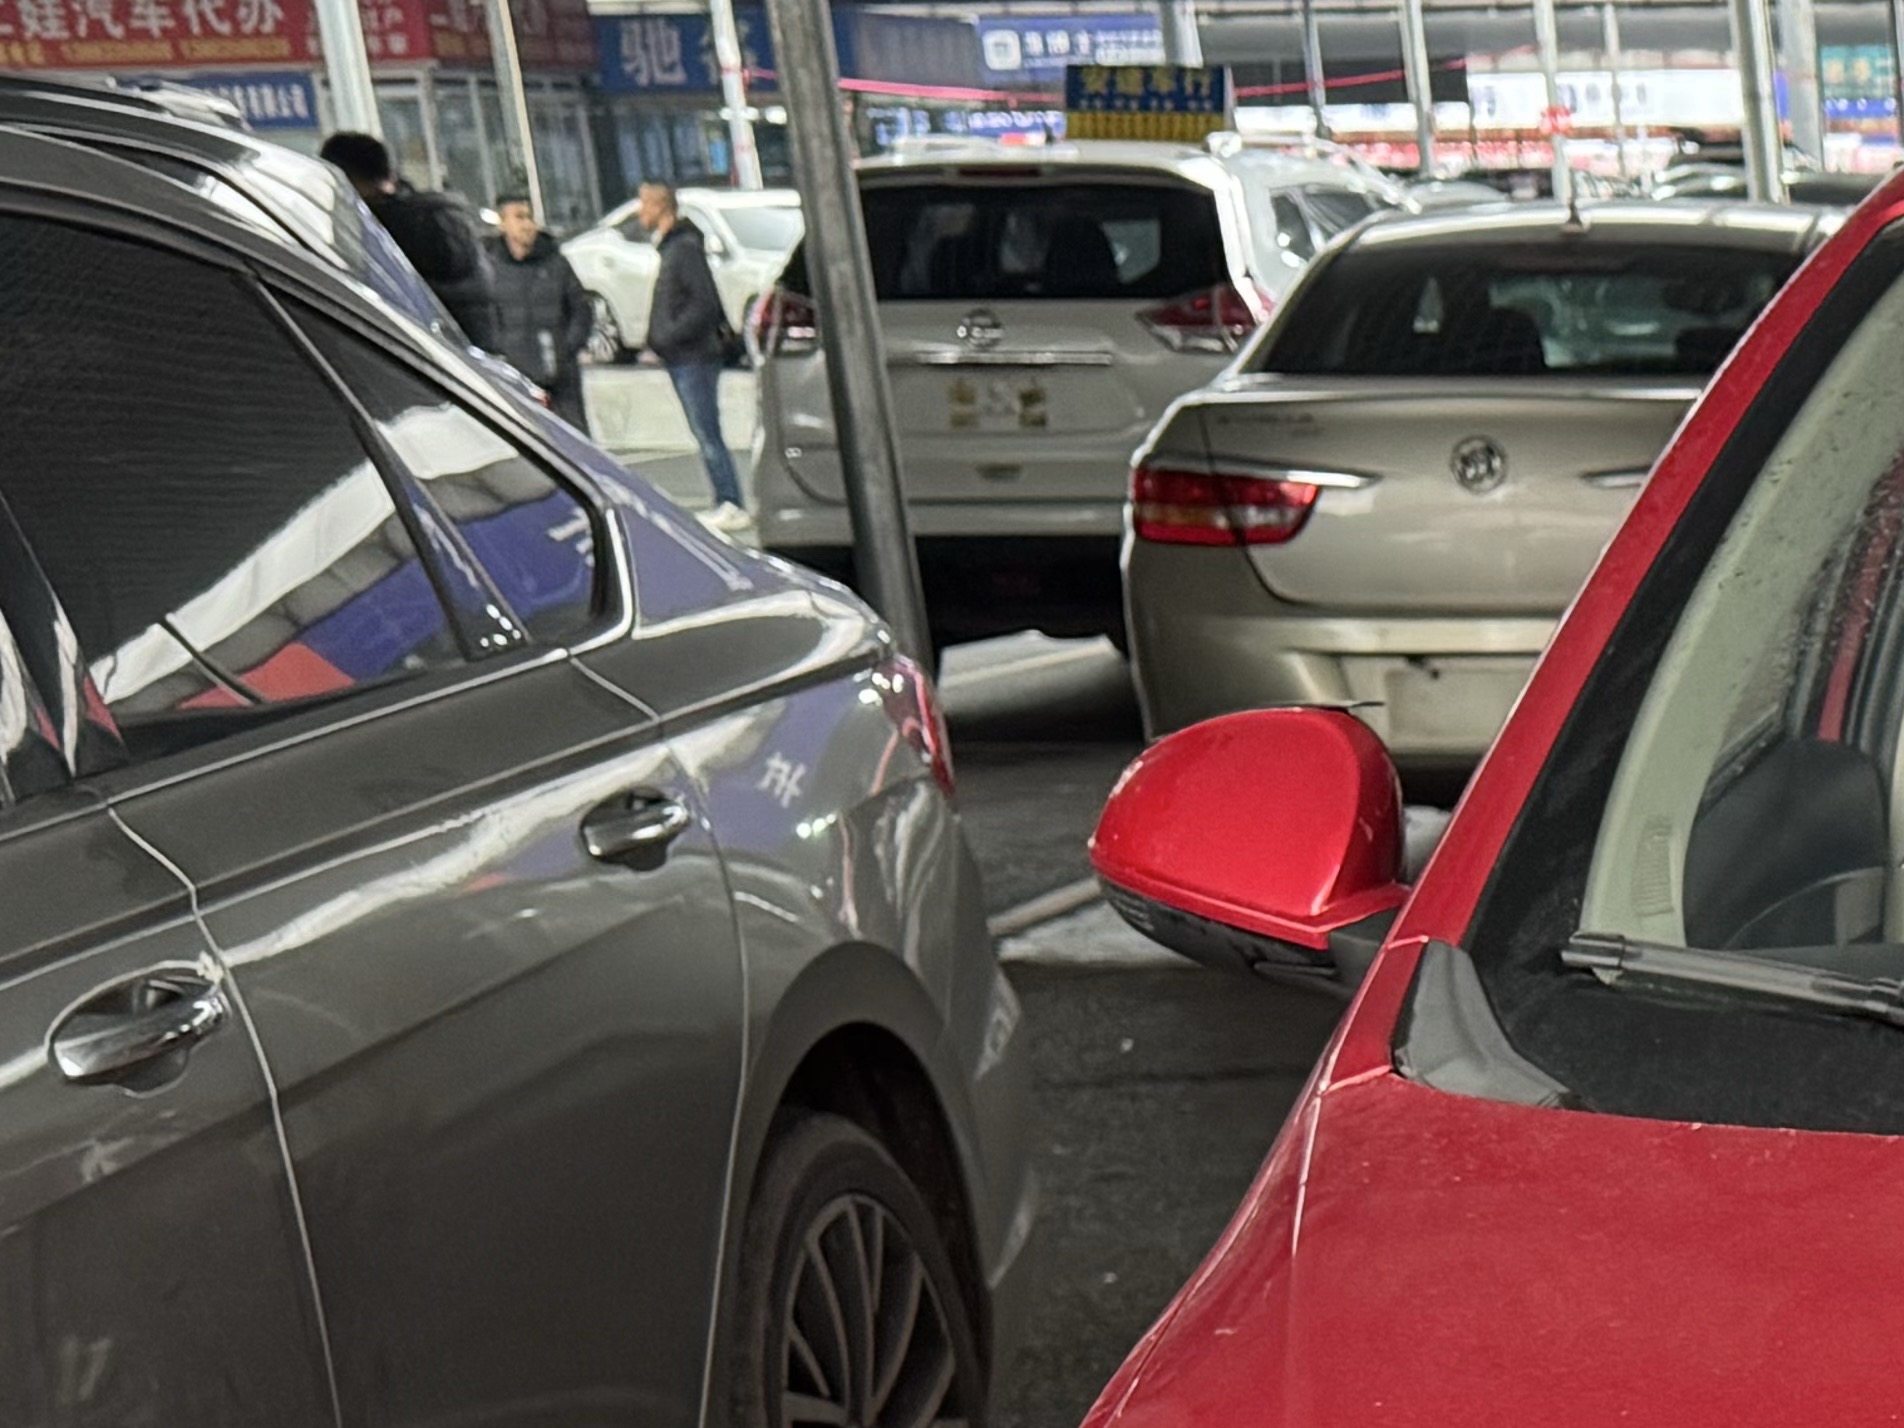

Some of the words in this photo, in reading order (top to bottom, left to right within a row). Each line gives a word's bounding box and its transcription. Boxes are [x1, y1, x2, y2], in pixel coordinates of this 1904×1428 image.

[0, 0, 284, 39] 娃汽车代办
